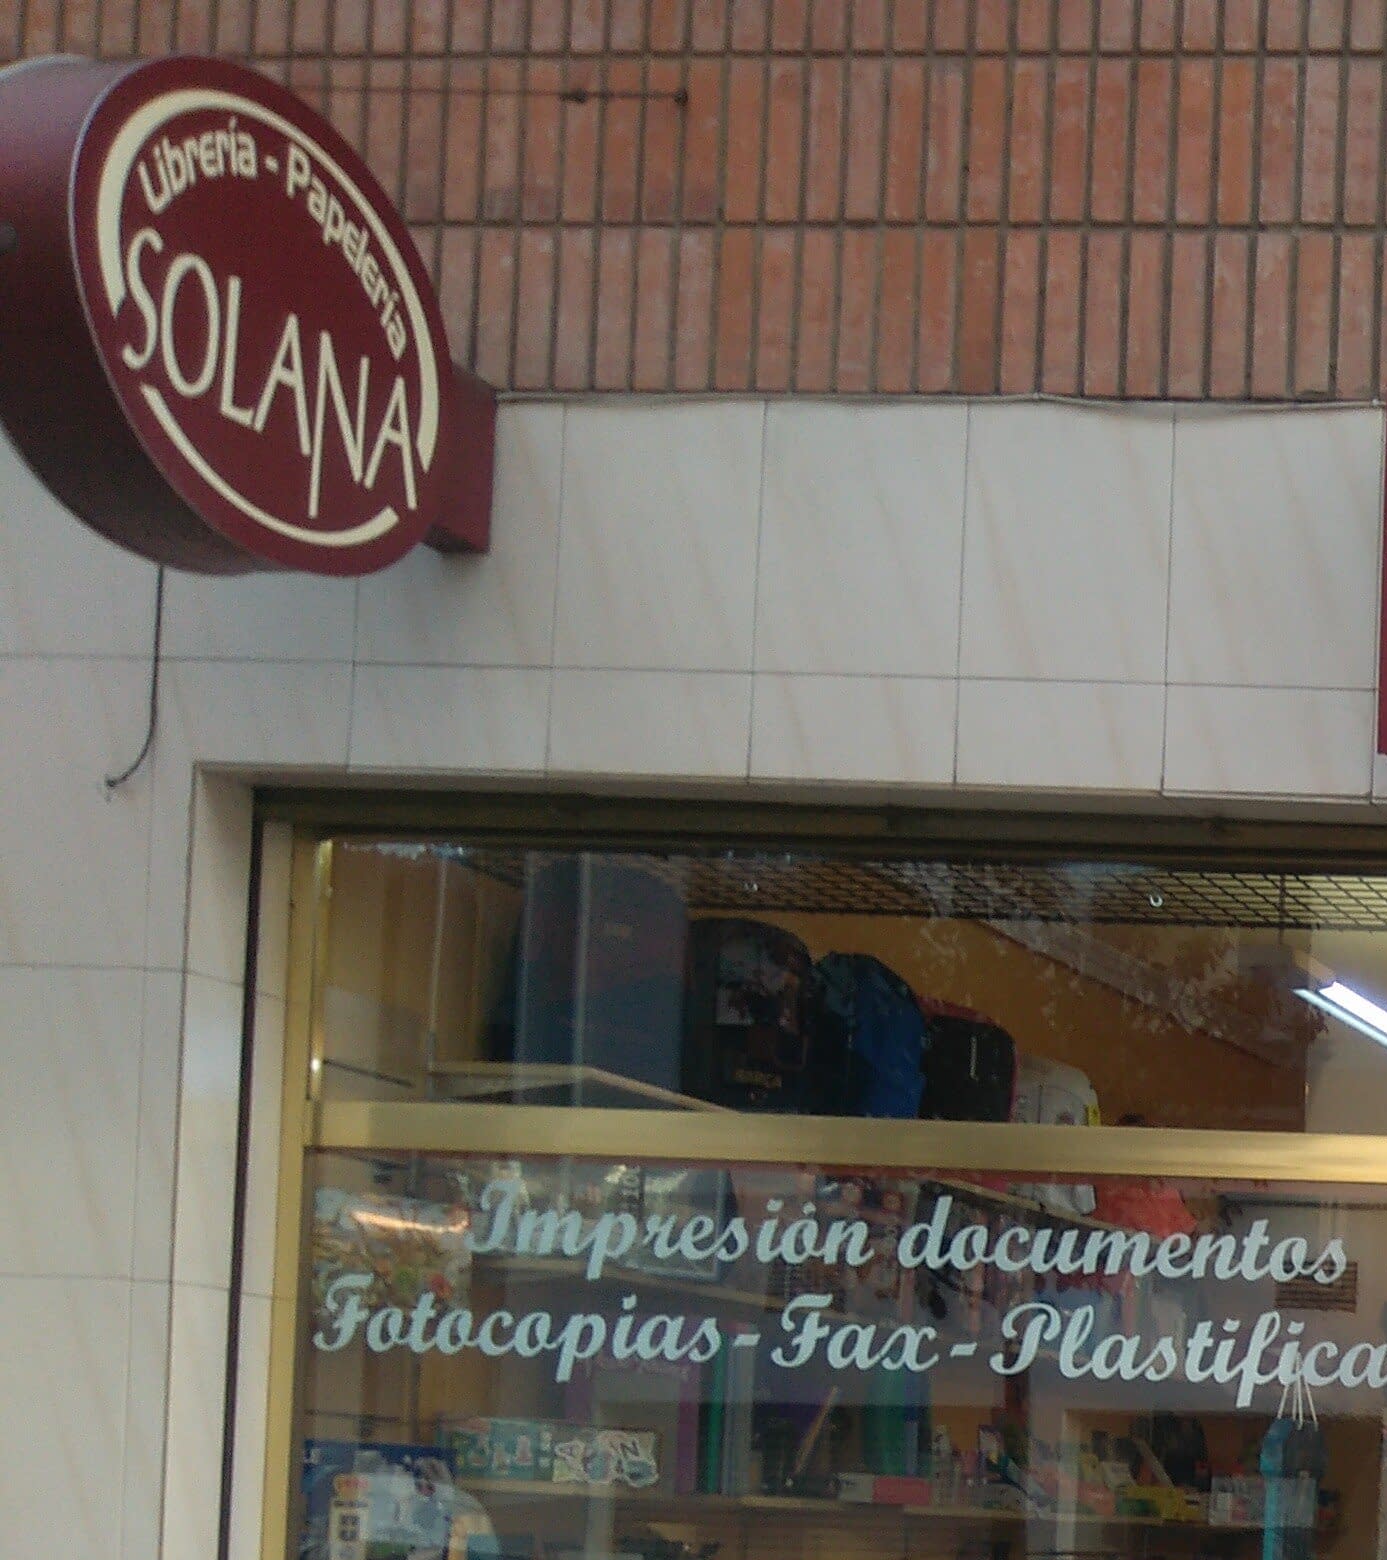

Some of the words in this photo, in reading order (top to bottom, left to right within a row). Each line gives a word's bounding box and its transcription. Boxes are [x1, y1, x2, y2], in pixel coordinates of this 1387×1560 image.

[137, 118, 258, 214] Librería
[286, 145, 405, 359] Papelería
[122, 227, 417, 519] SOLANA
[466, 1179, 873, 1278] Impresión
[896, 1196, 1348, 1285] documentos
